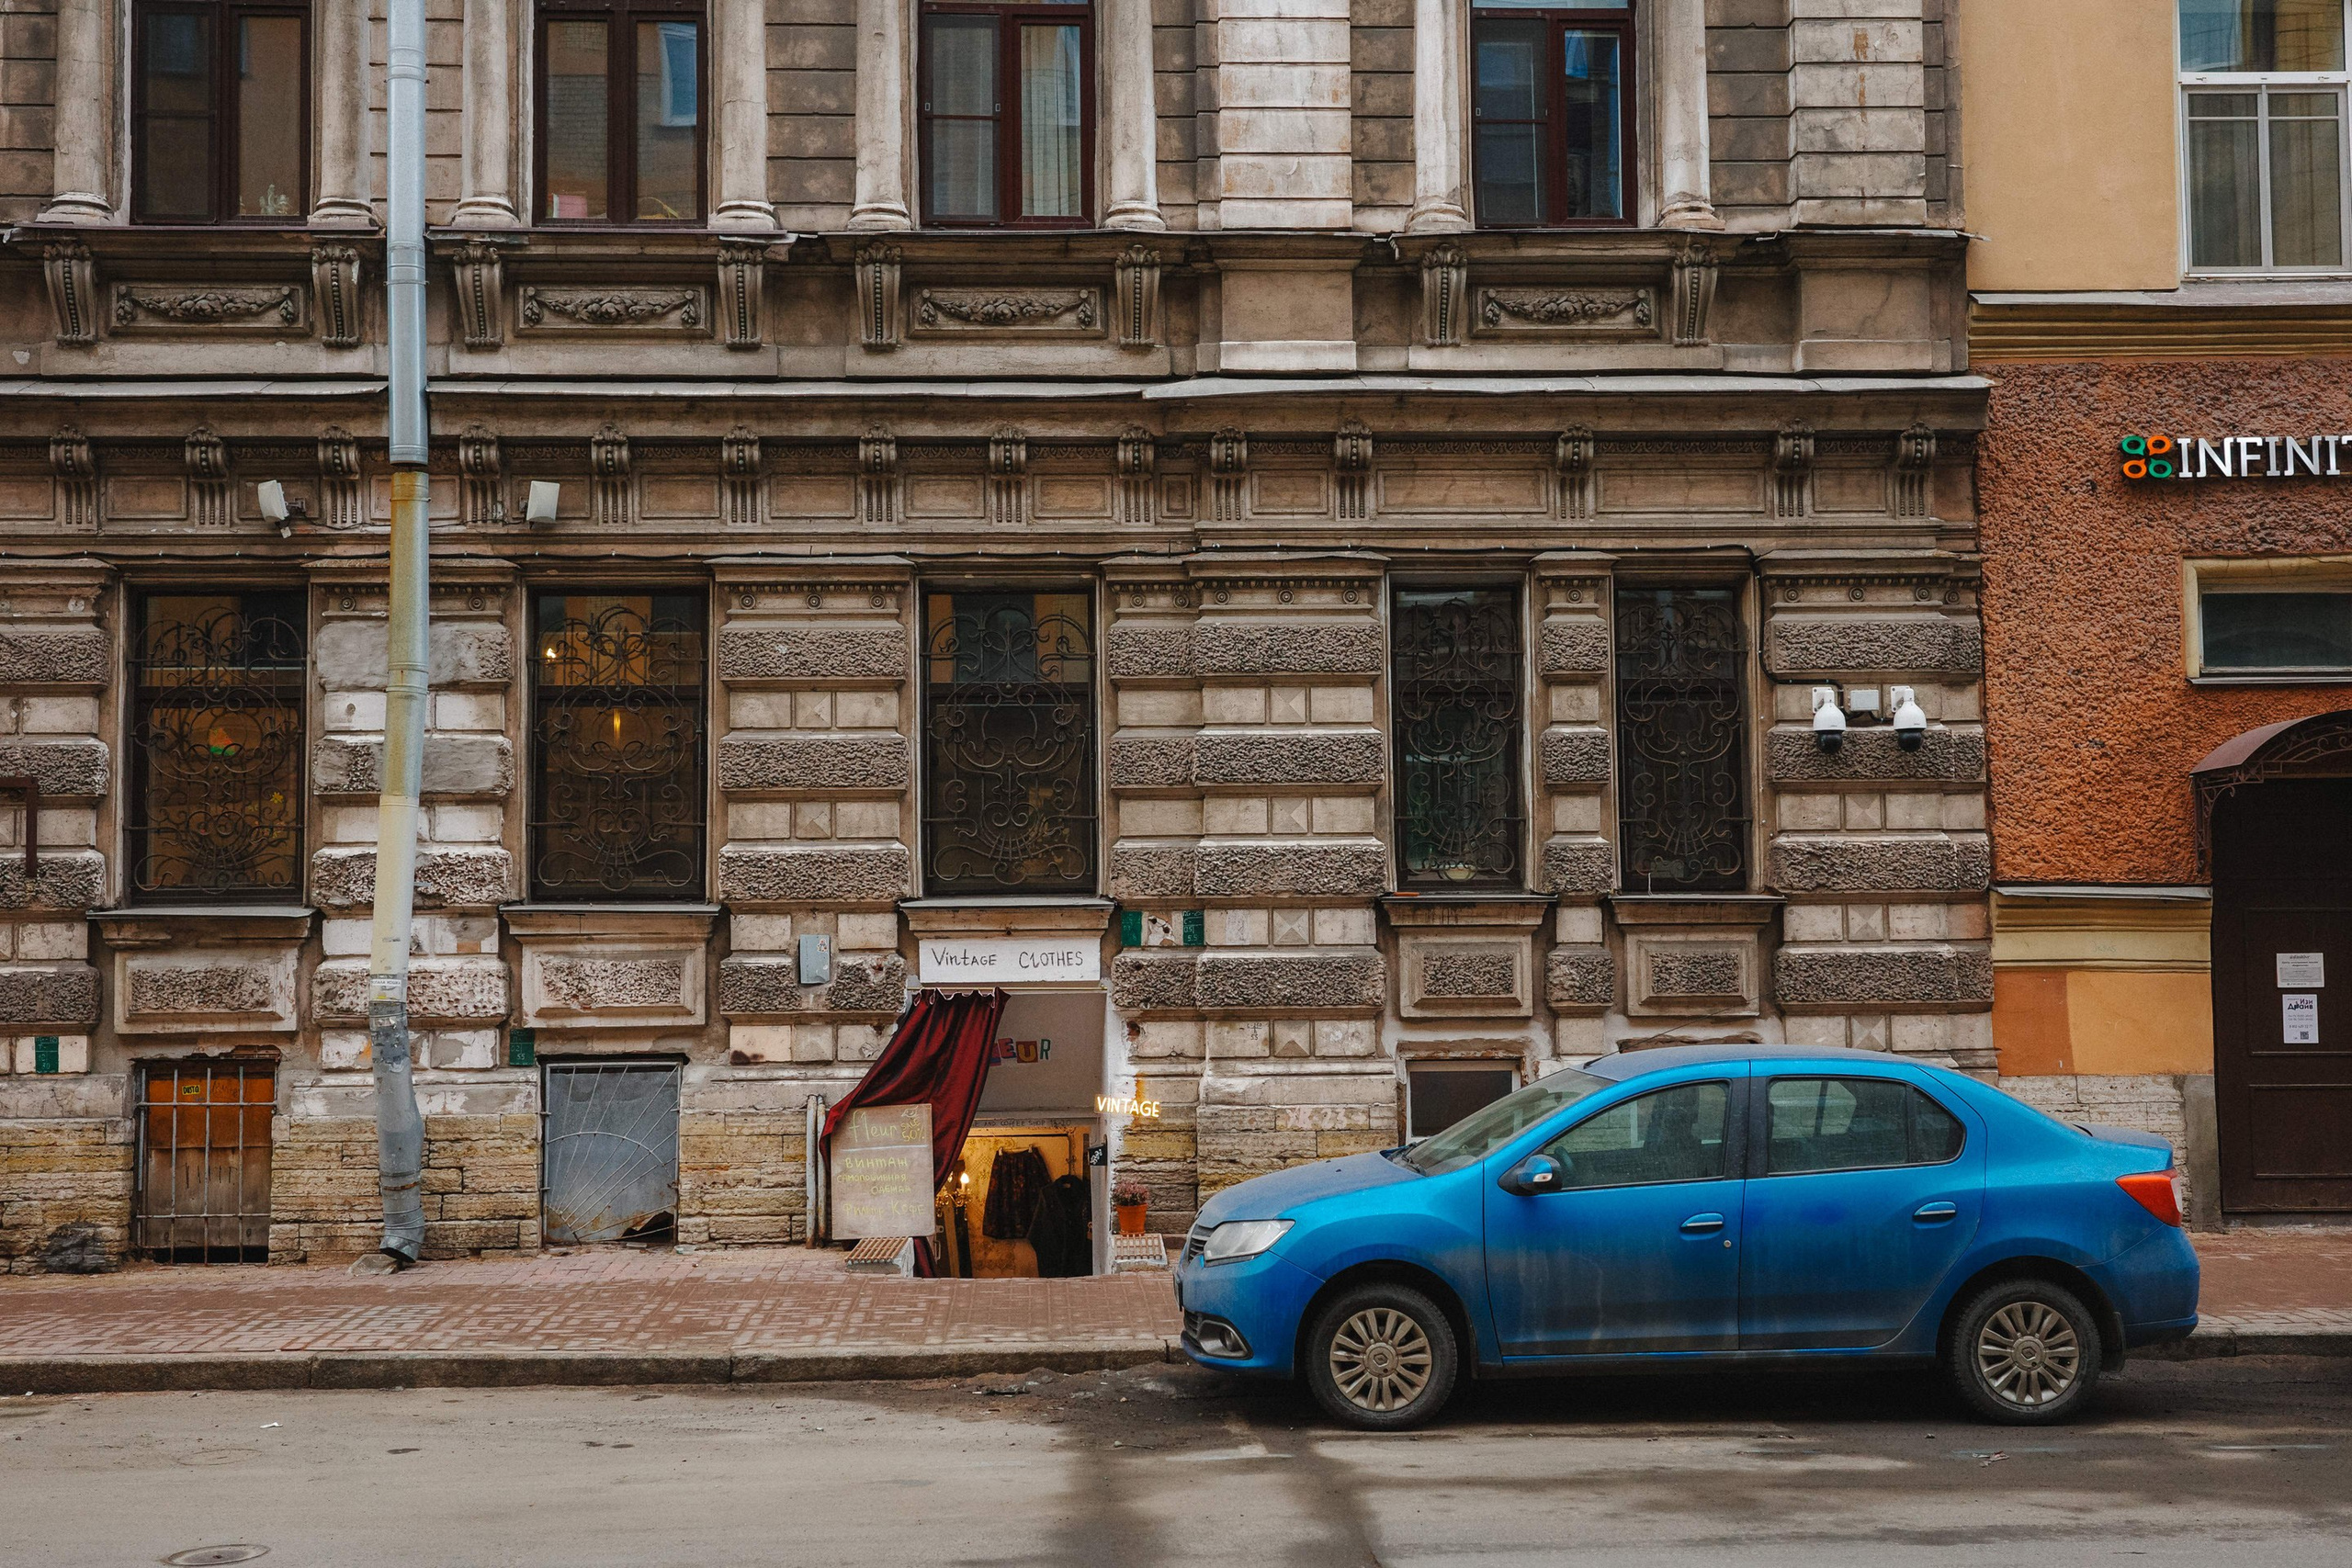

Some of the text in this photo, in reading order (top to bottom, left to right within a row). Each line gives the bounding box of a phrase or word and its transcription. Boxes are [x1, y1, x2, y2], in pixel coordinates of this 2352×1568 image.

[990, 1037, 1051, 1066] EUR
[1097, 1096, 1160, 1118] VINTAGE
[901, 1117, 922, 1131] SALE
[901, 1126, 925, 1142] 50%
